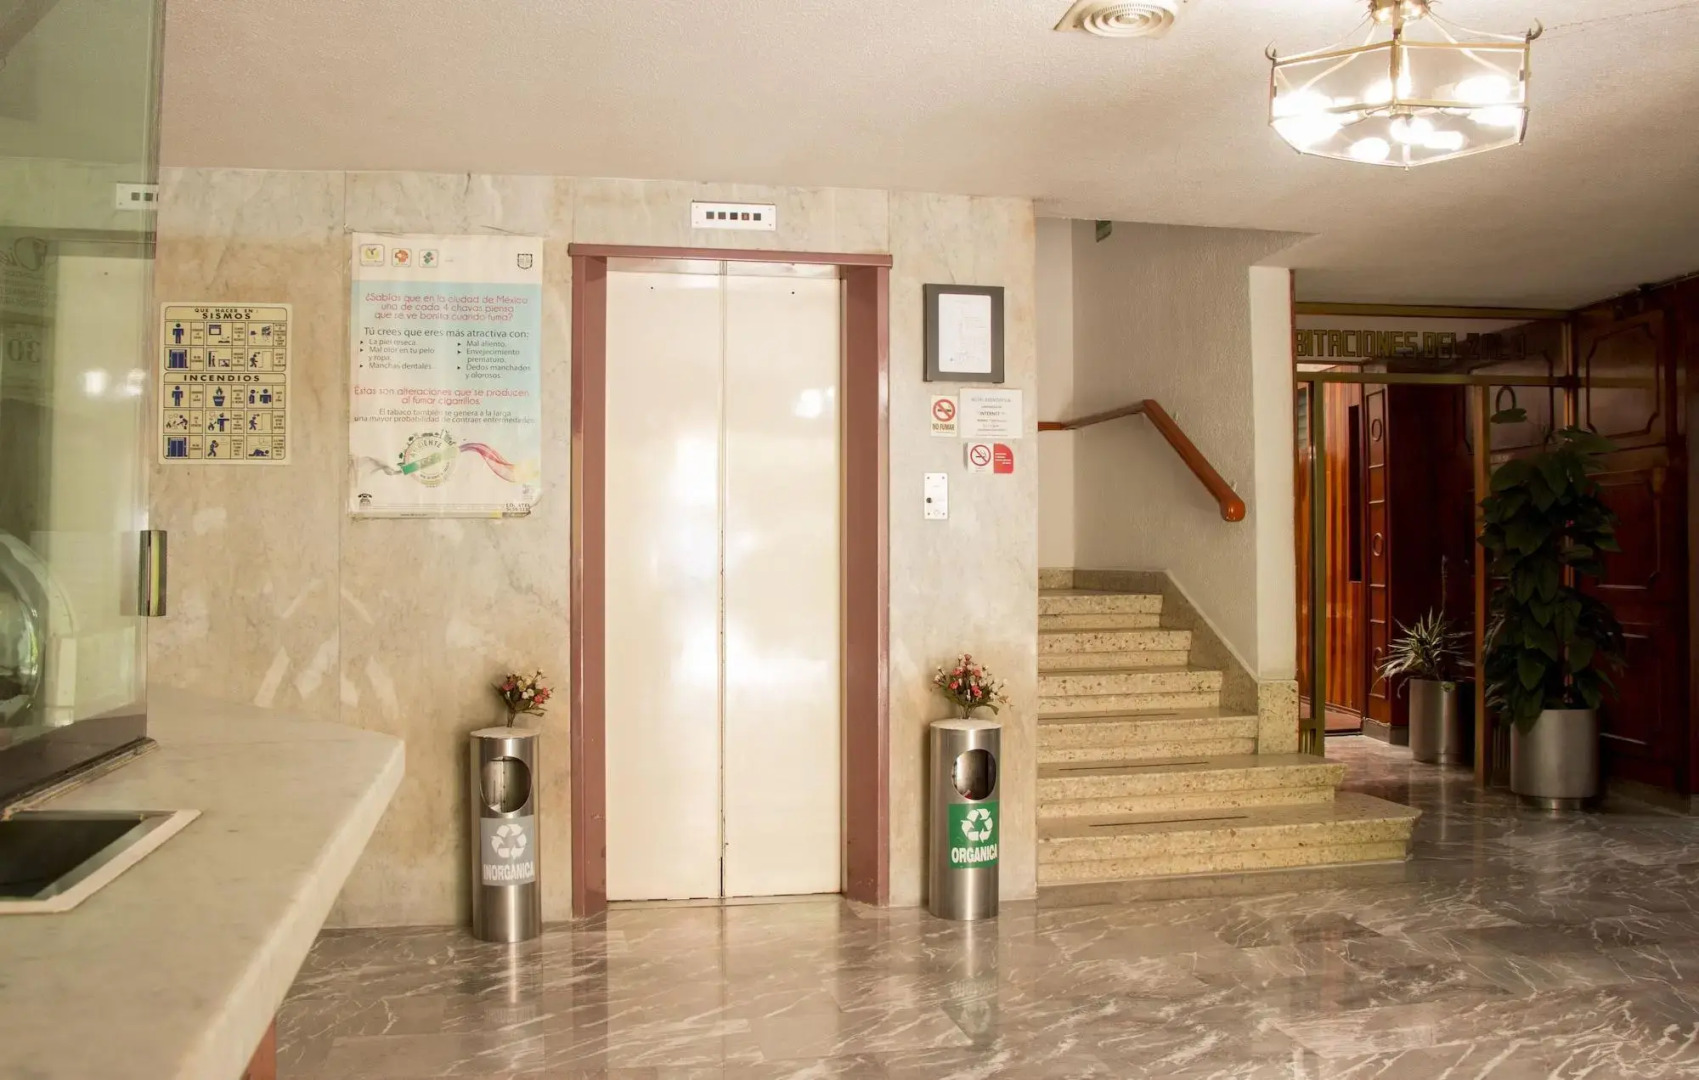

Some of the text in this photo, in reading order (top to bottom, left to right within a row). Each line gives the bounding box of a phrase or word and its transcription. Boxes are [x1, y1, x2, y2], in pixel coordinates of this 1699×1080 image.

[404, 294, 421, 304] que
[423, 294, 434, 302] en
[437, 293, 445, 302] la
[448, 293, 479, 303] ciudad
[482, 294, 494, 304] de
[496, 294, 528, 304] México
[381, 302, 514, 314] una de cada 4 chavas piensa
[202, 312, 251, 320] SISMOS
[374, 310, 513, 322] que se ve bonita cuando fuma?
[364, 326, 529, 339] Tú crees que eres más atractiva con:
[379, 339, 392, 347] piel
[1423, 330, 1461, 359] DEL
[383, 346, 397, 354] olor
[419, 347, 436, 356] pelo
[466, 348, 520, 356] Envejecimiento
[466, 363, 531, 372] Dedos manchados
[184, 374, 260, 382] INCENDIOS
[379, 387, 394, 395] son
[397, 387, 453, 397] alteraciones
[454, 389, 471, 398] que
[474, 389, 484, 397] se
[486, 388, 530, 398] producen
[401, 396, 410, 405] al
[412, 396, 436, 405] fumar
[379, 408, 386, 416] El
[387, 408, 412, 416] tabaco
[413, 408, 443, 416] también
[445, 409, 452, 417] se
[453, 410, 478, 419] genera
[485, 408, 492, 417] la
[493, 409, 512, 419] larga
[369, 415, 392, 424] mayor
[394, 415, 440, 424] probabilidad
[452, 416, 481, 424] contraer
[932, 423, 955, 431] NO FUMAR
[951, 844, 998, 863] ORGANICA
[483, 863, 535, 881] INORGANICA
